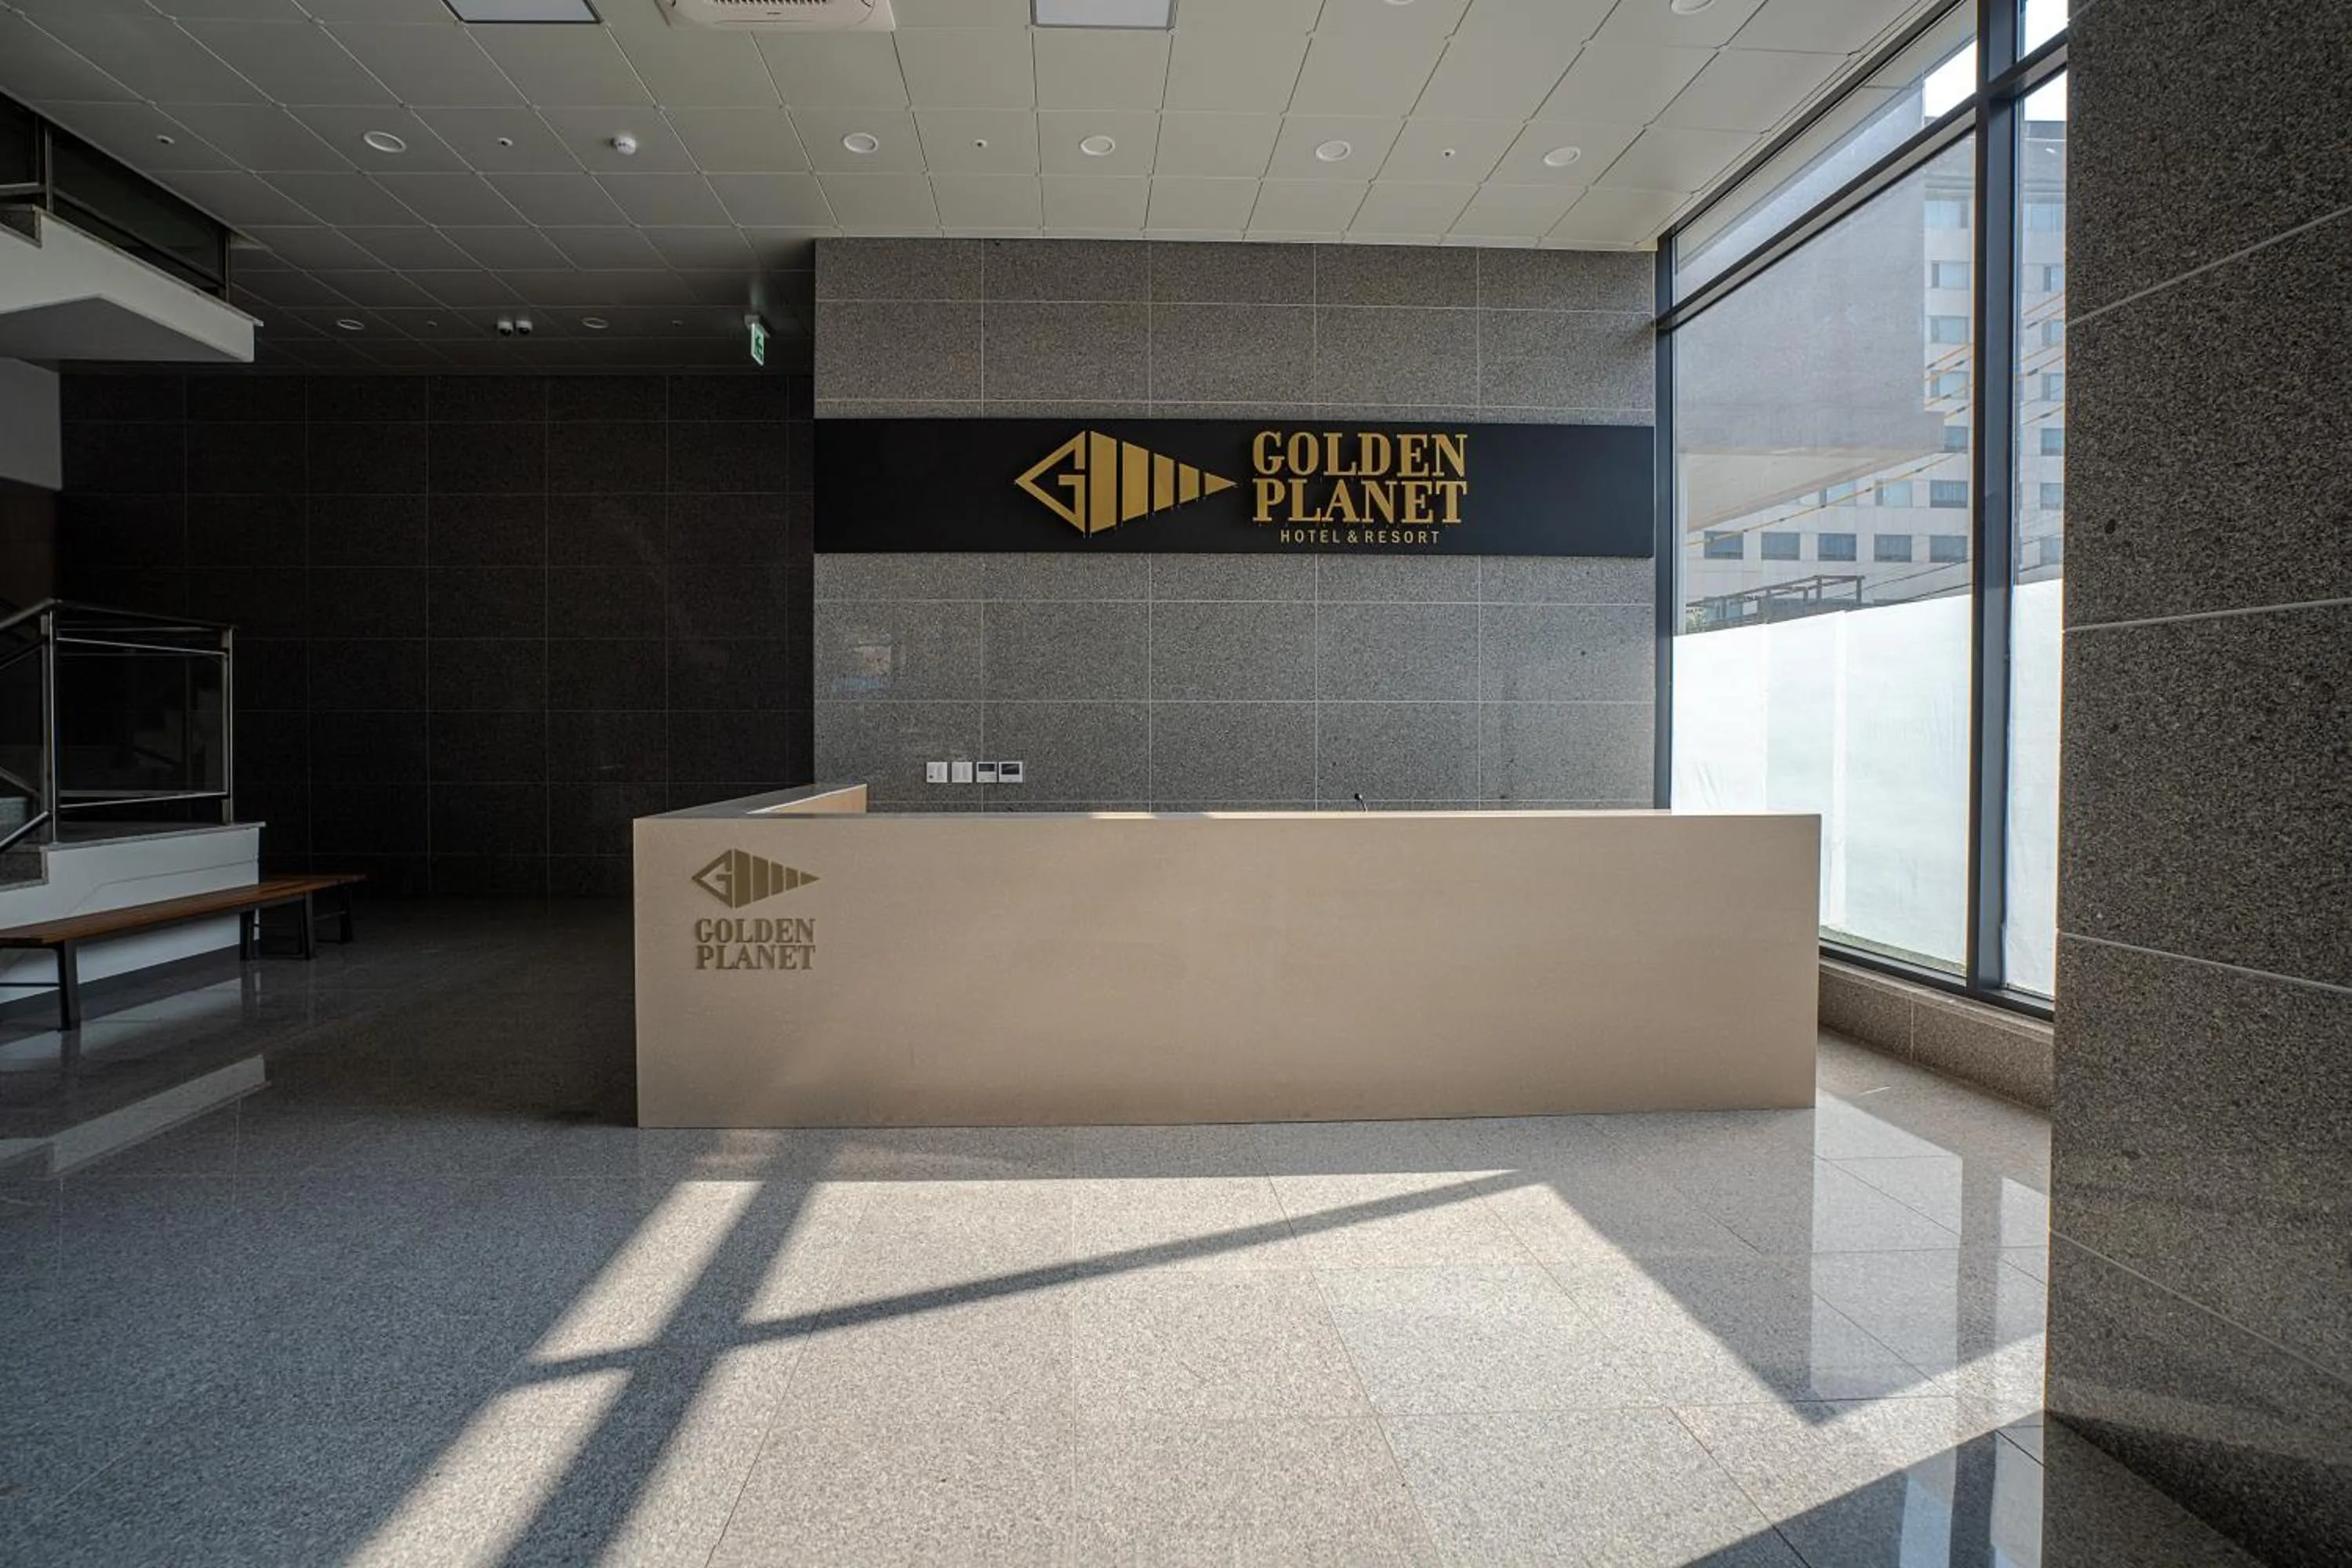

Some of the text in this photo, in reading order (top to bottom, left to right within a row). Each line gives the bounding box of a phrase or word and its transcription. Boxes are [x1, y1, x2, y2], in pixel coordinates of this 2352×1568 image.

[1252, 431, 1468, 477] GOLDEN
[1252, 478, 1468, 524] PLANET
[1280, 529, 1439, 544] HOTEL & RESORT
[695, 918, 816, 943] GOLDEN
[695, 945, 816, 970] PLANET
